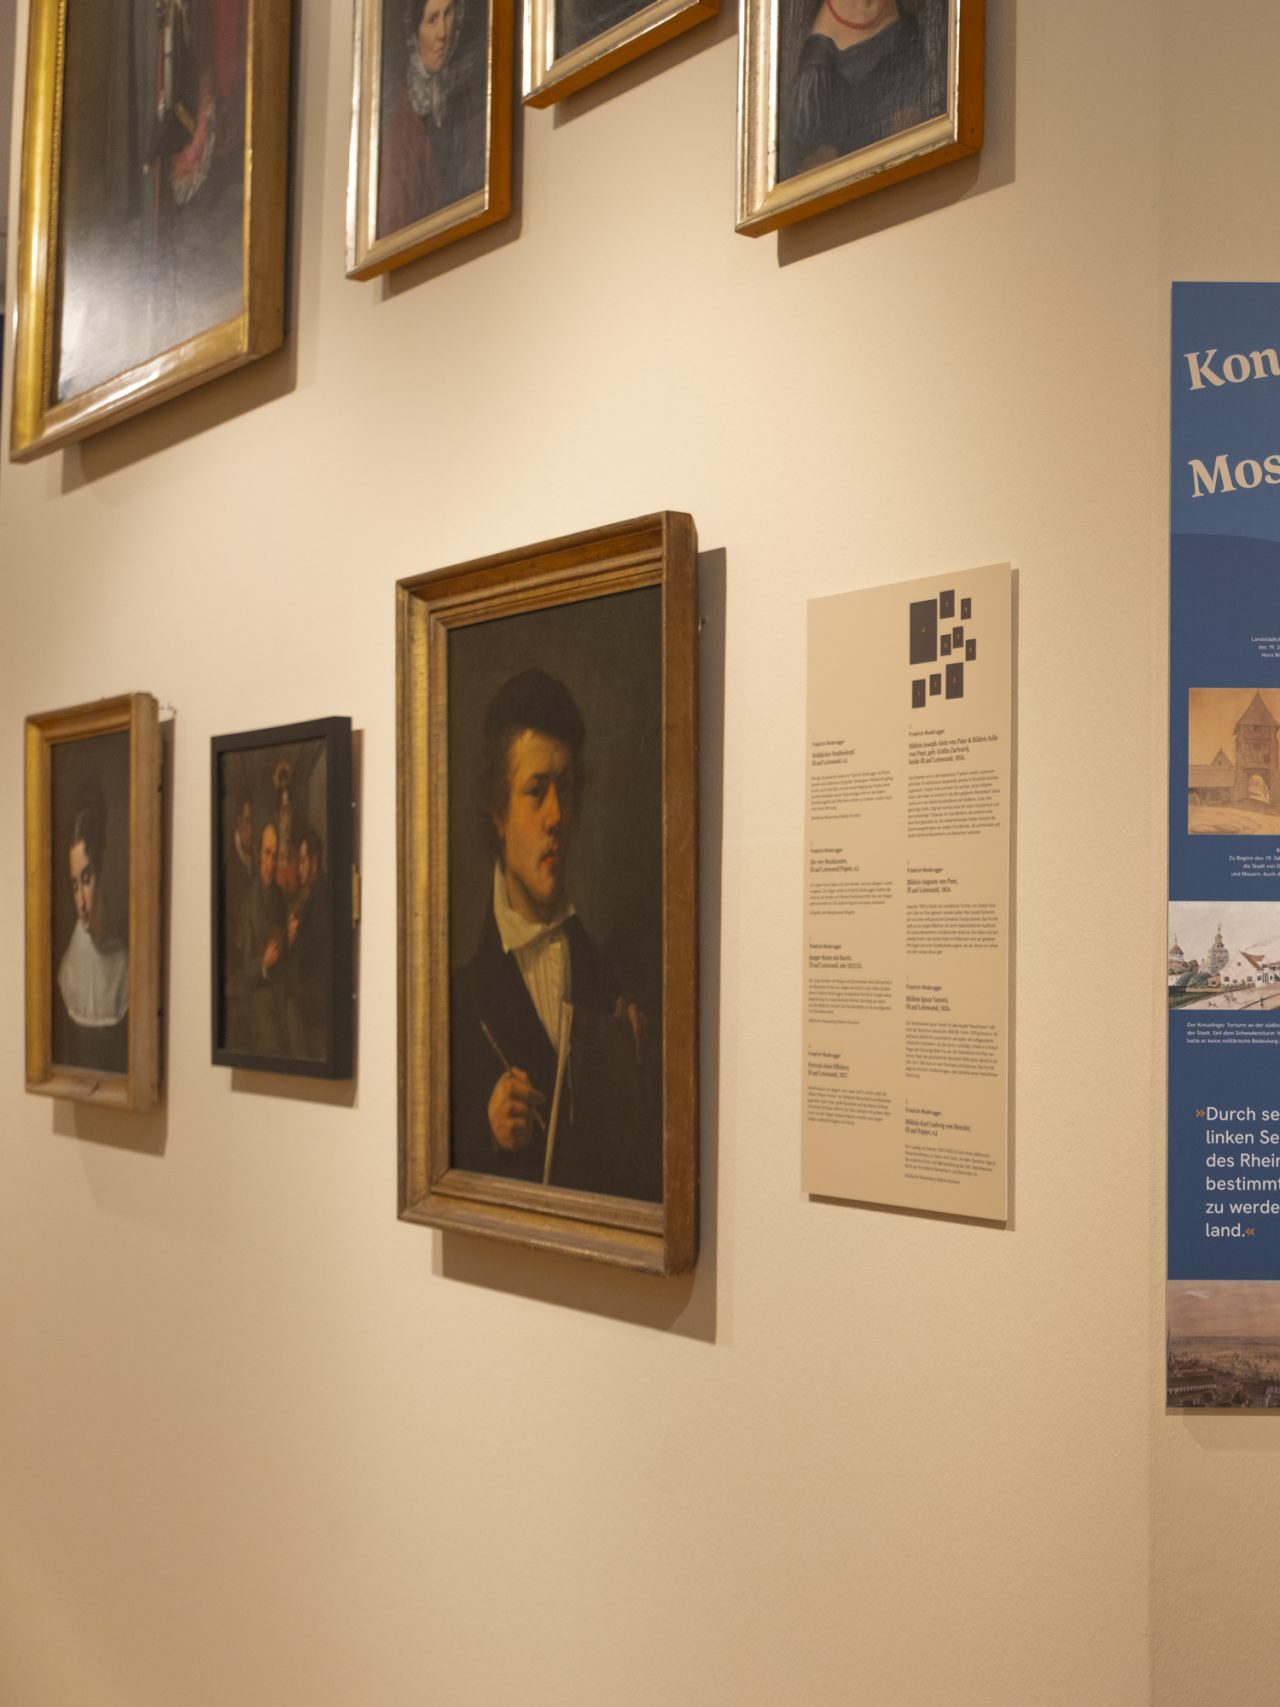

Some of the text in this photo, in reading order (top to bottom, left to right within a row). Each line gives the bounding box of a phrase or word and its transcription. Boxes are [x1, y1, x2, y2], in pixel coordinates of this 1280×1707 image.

[1206, 1130, 1254, 1145] linken
[1205, 1154, 1235, 1168] des
[1205, 1204, 1224, 1215] zu
